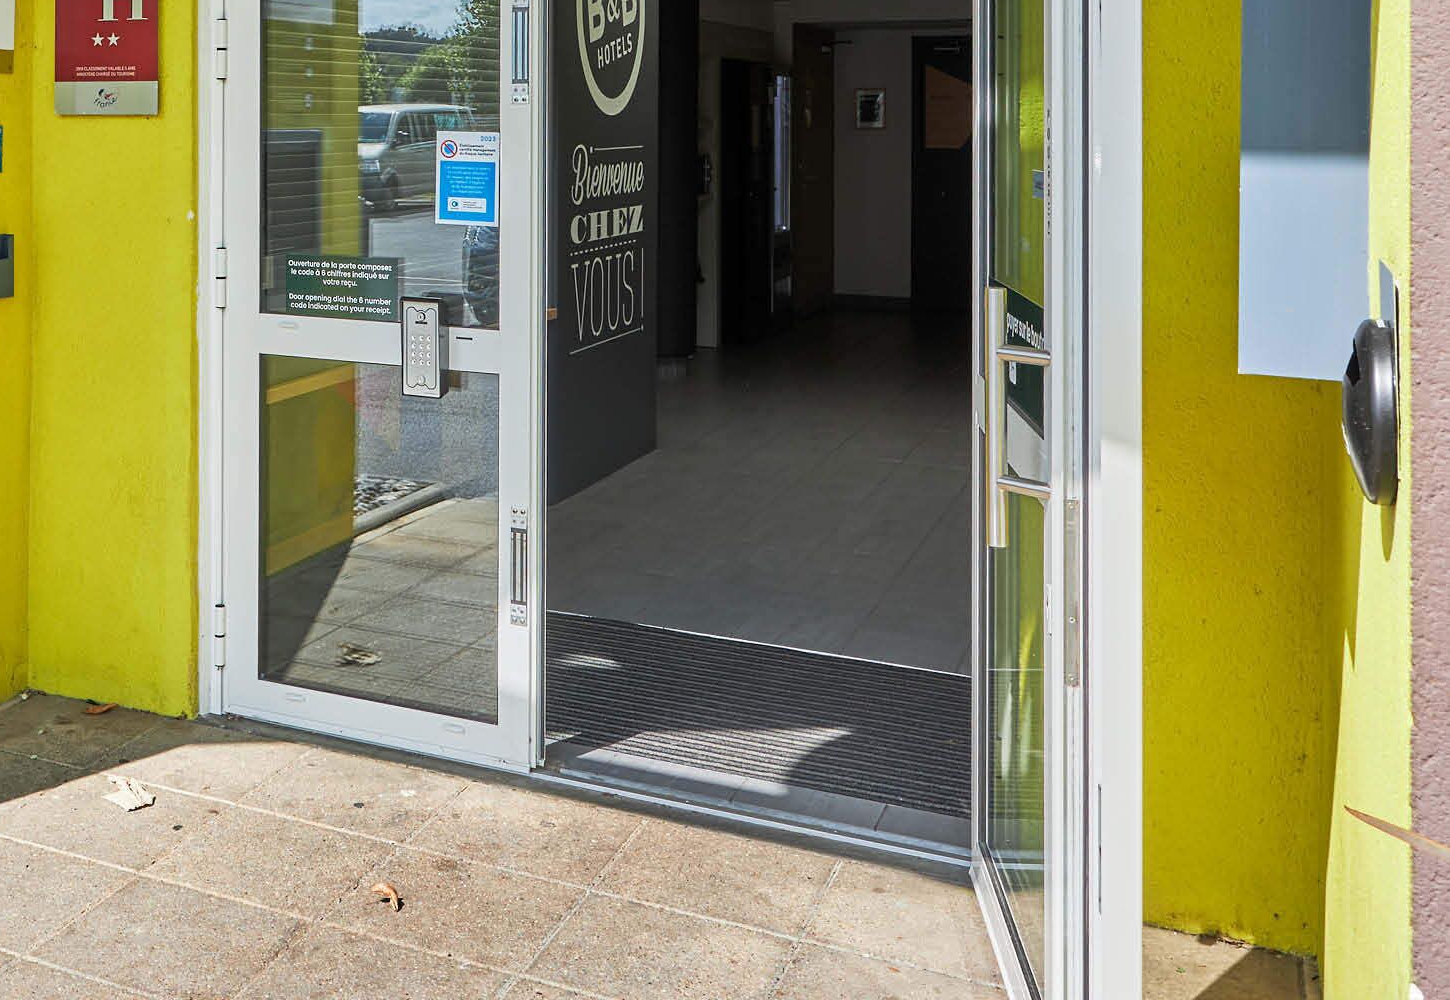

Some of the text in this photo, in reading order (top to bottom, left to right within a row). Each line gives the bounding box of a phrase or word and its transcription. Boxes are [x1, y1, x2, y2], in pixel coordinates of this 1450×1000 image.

[597, 32, 633, 70] HOTELS
[570, 143, 645, 206] Bienvenue
[570, 203, 645, 245] CHEZ
[288, 259, 320, 268] Ouverture
[330, 261, 337, 269] la
[338, 262, 356, 271] porte
[357, 264, 392, 272] composez
[297, 268, 314, 276] code
[326, 269, 351, 278] chiffres
[352, 271, 377, 280] indiqué
[341, 280, 357, 288] reçu.
[288, 292, 304, 300] Door
[305, 294, 332, 303] opening
[332, 295, 346, 303] dial
[364, 297, 392, 305] number
[308, 302, 339, 311] indicated
[349, 305, 365, 313] your
[365, 306, 392, 315] receipt.
